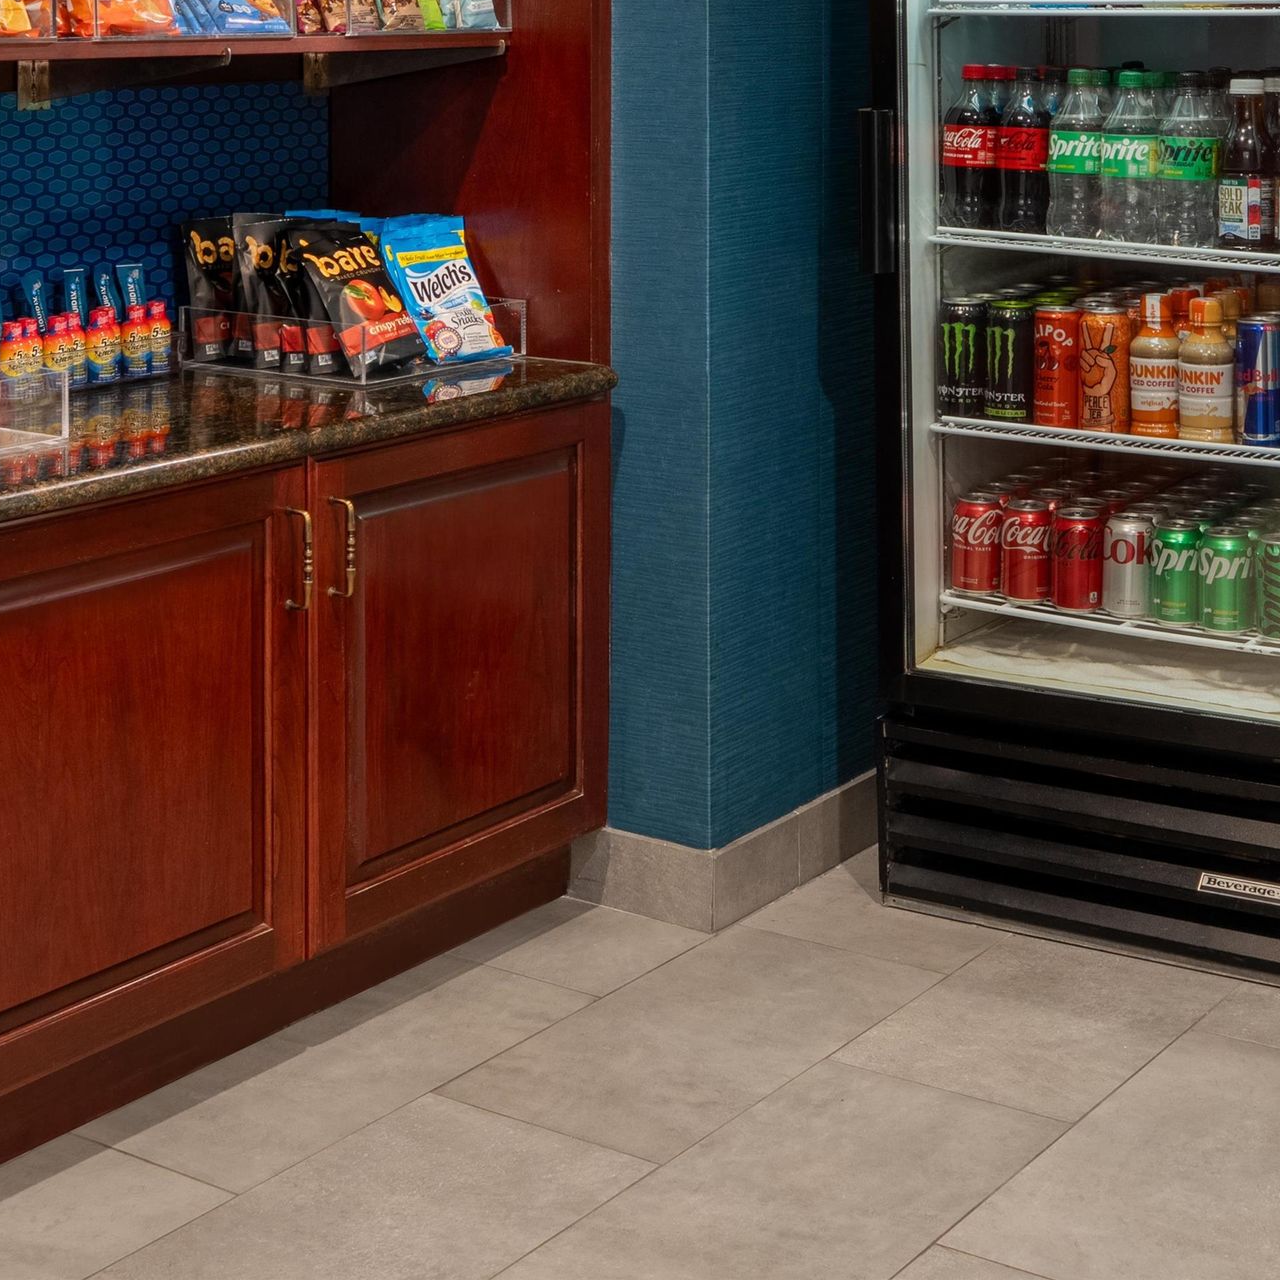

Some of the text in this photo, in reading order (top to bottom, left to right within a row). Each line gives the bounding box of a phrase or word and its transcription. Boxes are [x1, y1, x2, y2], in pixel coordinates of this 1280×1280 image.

[1050, 135, 1102, 160] Sprite
[1158, 139, 1213, 164] Sprite
[304, 245, 380, 277] bare
[411, 264, 472, 302] Welch's
[370, 321, 396, 335] crispy
[1147, 380, 1175, 388] COFFEE
[1187, 386, 1215, 394] COFFEE
[1085, 396, 1108, 409] PEACE
[1140, 400, 1164, 408] original
[1089, 410, 1102, 418] TEA
